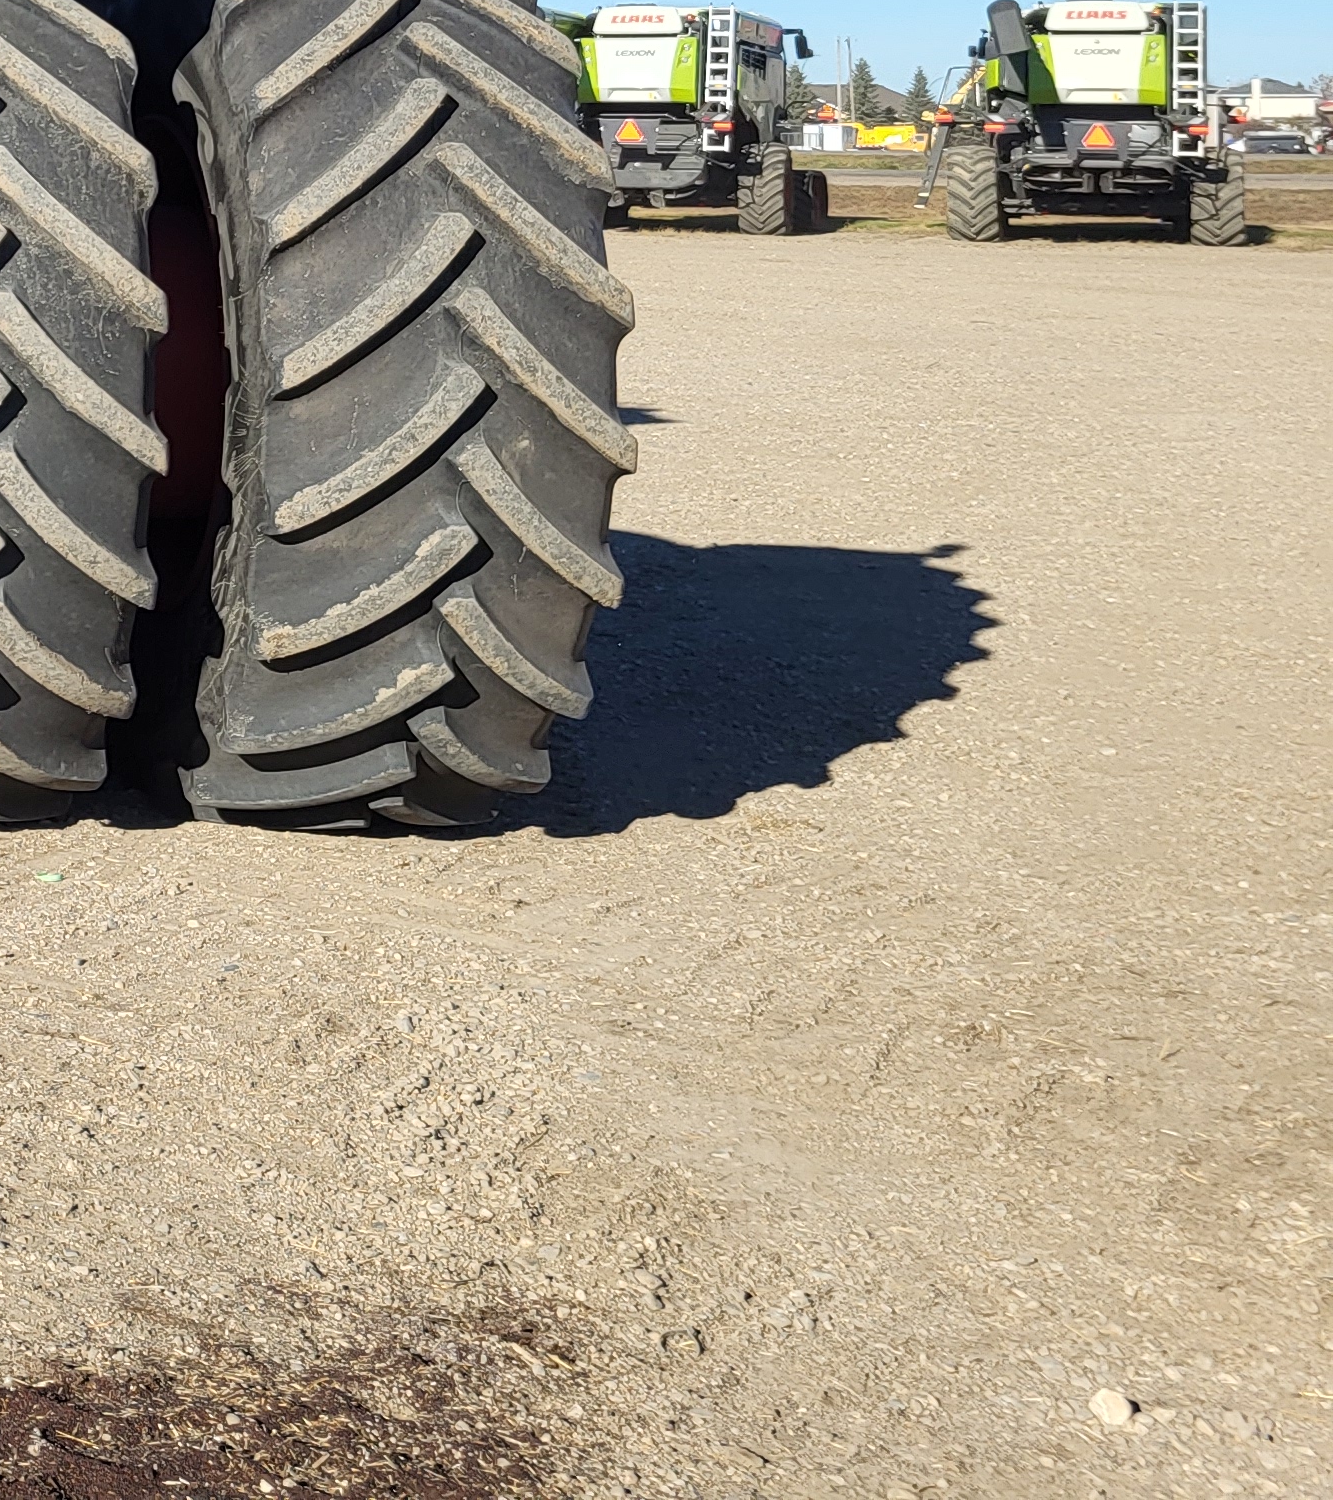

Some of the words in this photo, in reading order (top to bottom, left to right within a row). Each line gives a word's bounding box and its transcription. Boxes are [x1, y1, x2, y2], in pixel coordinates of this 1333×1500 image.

[1065, 10, 1127, 19] CLAAS
[611, 14, 664, 24] CLAAS
[615, 49, 655, 57] LEXION
[1074, 48, 1121, 56] LEXION
